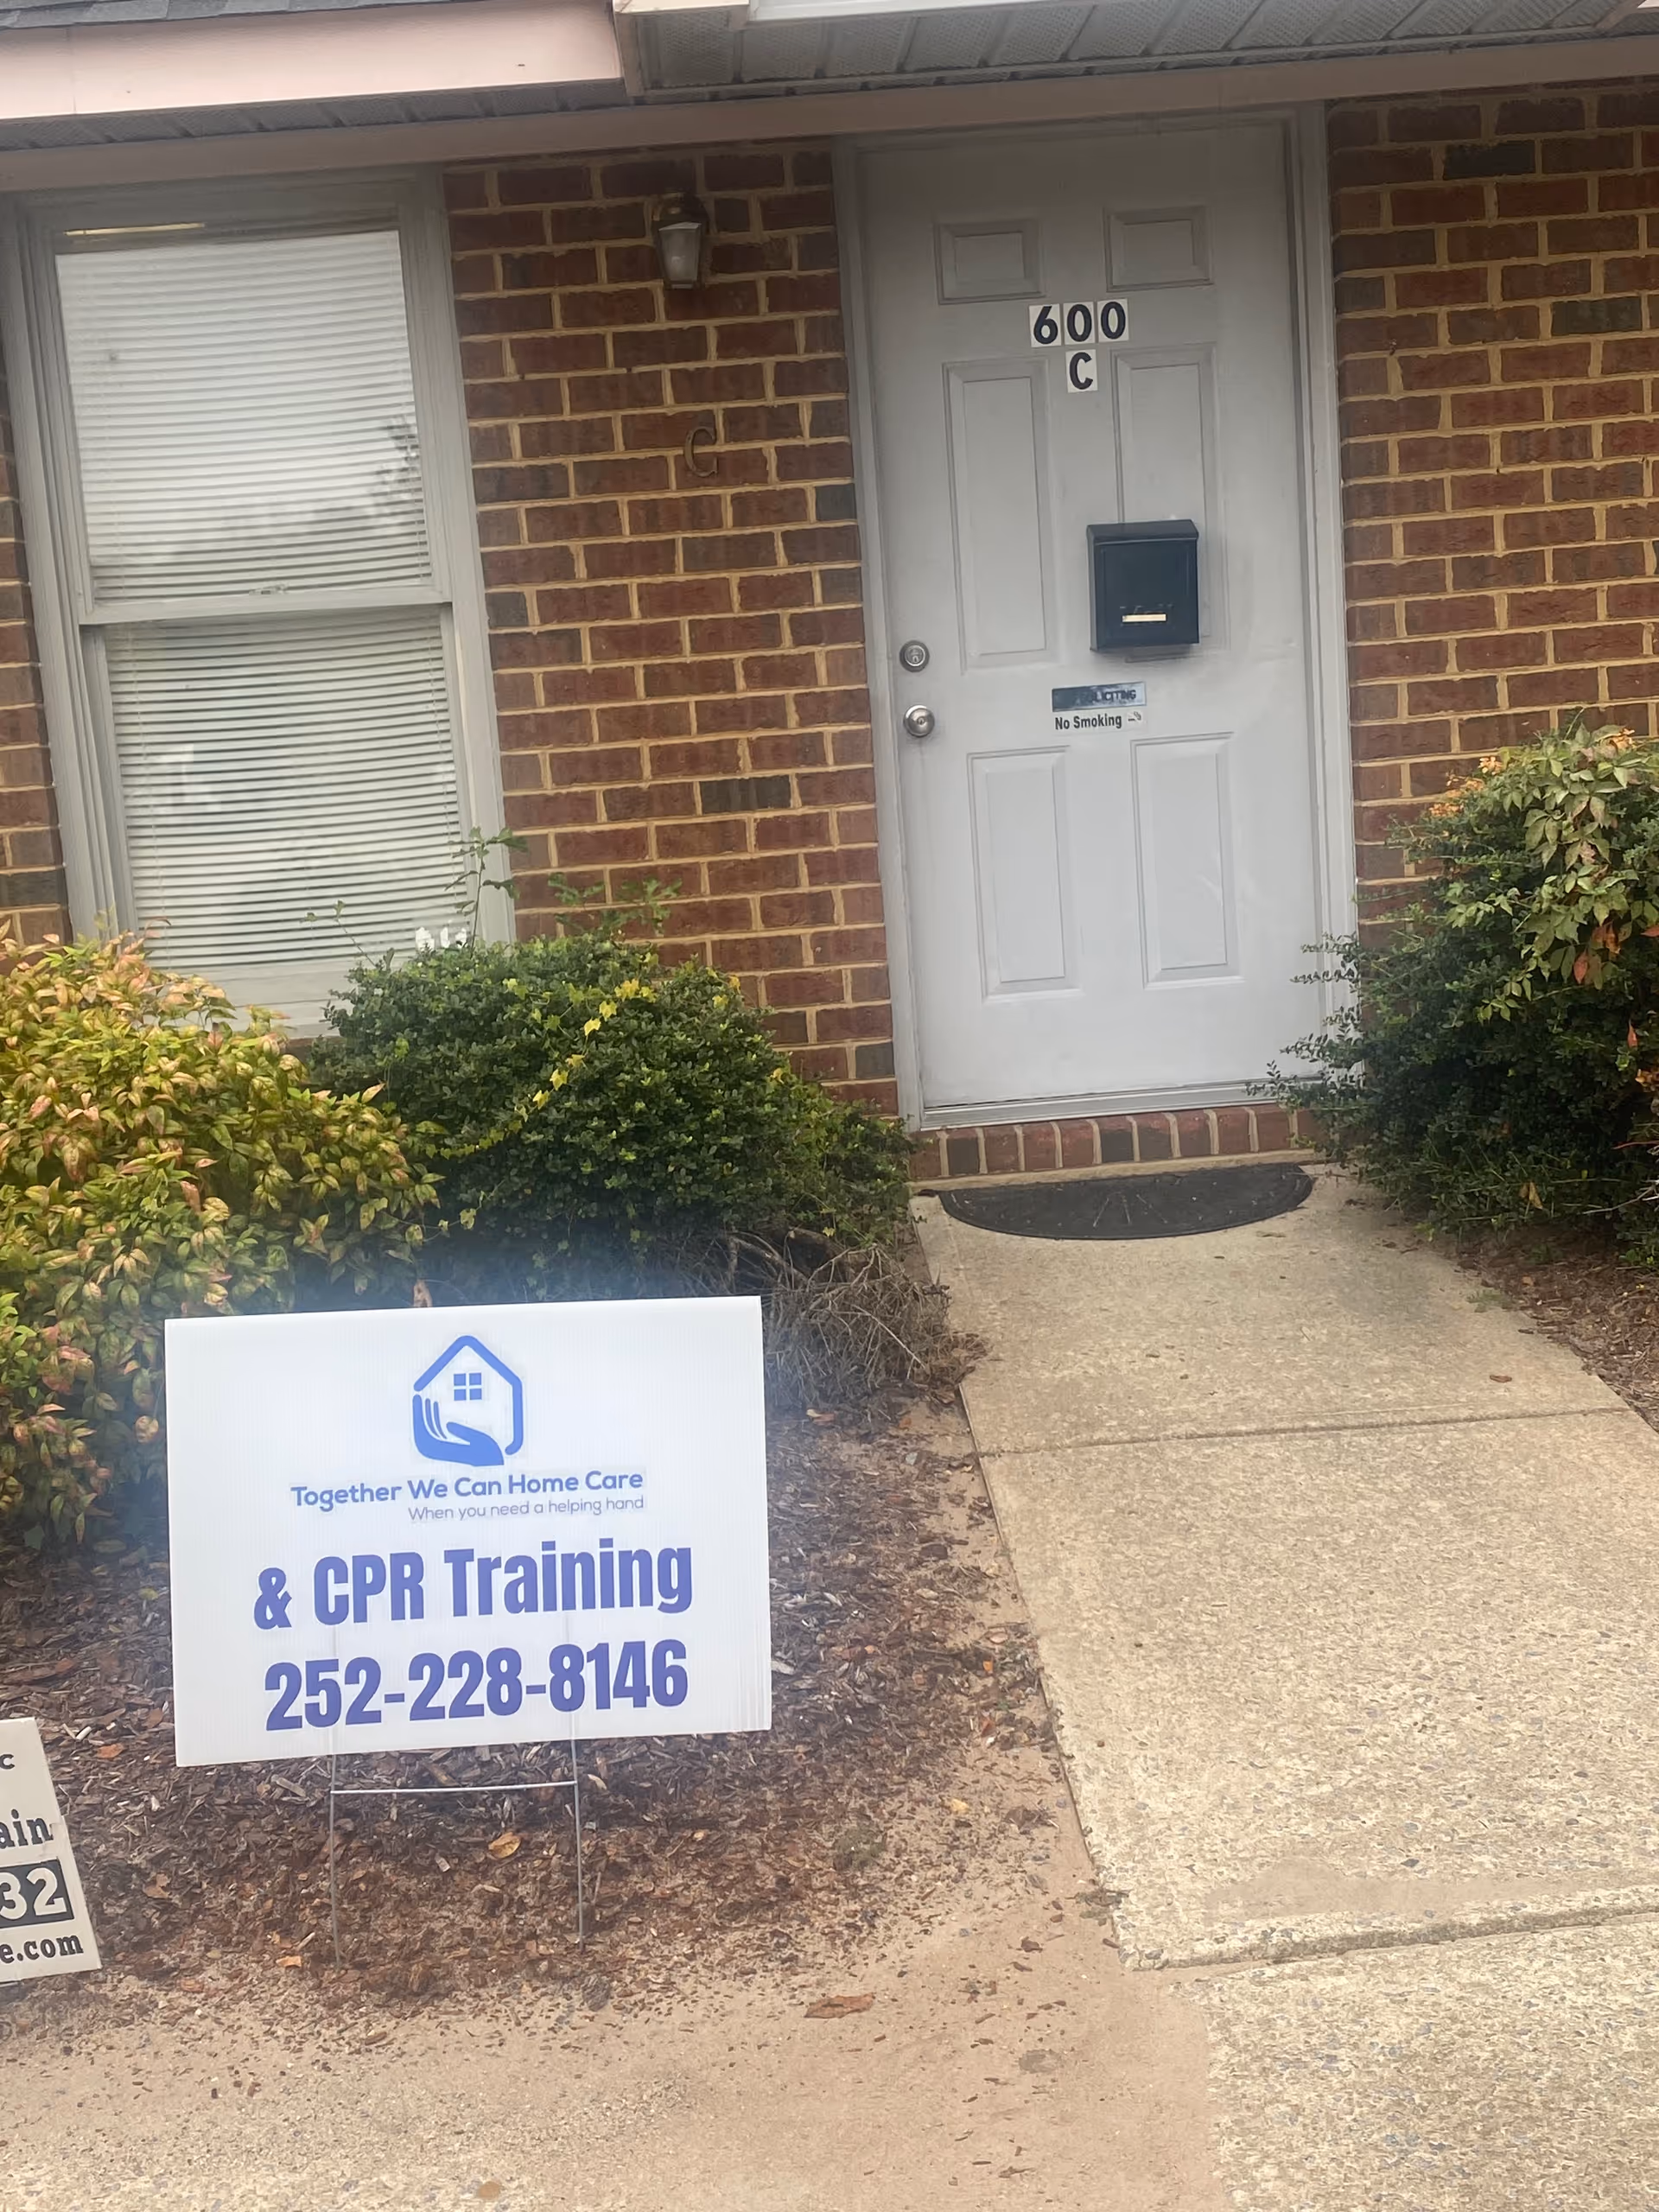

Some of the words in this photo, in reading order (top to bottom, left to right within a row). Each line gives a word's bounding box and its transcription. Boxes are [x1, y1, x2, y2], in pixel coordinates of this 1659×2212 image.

[1033, 301, 1127, 346] 600
[1068, 351, 1095, 391] C
[1054, 716, 1071, 730] No
[1073, 713, 1122, 729] Smoking
[290, 1482, 403, 1513] Together
[407, 1478, 448, 1500] We
[454, 1476, 502, 1497] Can
[508, 1473, 579, 1494] Home
[585, 1470, 644, 1491] Care
[408, 1506, 454, 1521] When
[458, 1505, 486, 1521] you
[490, 1500, 530, 1516] need
[533, 1503, 543, 1514] a
[548, 1497, 602, 1516] helping
[606, 1495, 644, 1510] hand
[253, 1567, 293, 1630] &
[313, 1551, 425, 1626] CPR
[443, 1537, 693, 1618] Training
[264, 1639, 689, 1732] 252-228-8146
[0, 1867, 67, 1920] 32
[0, 1935, 85, 1964] e.com
